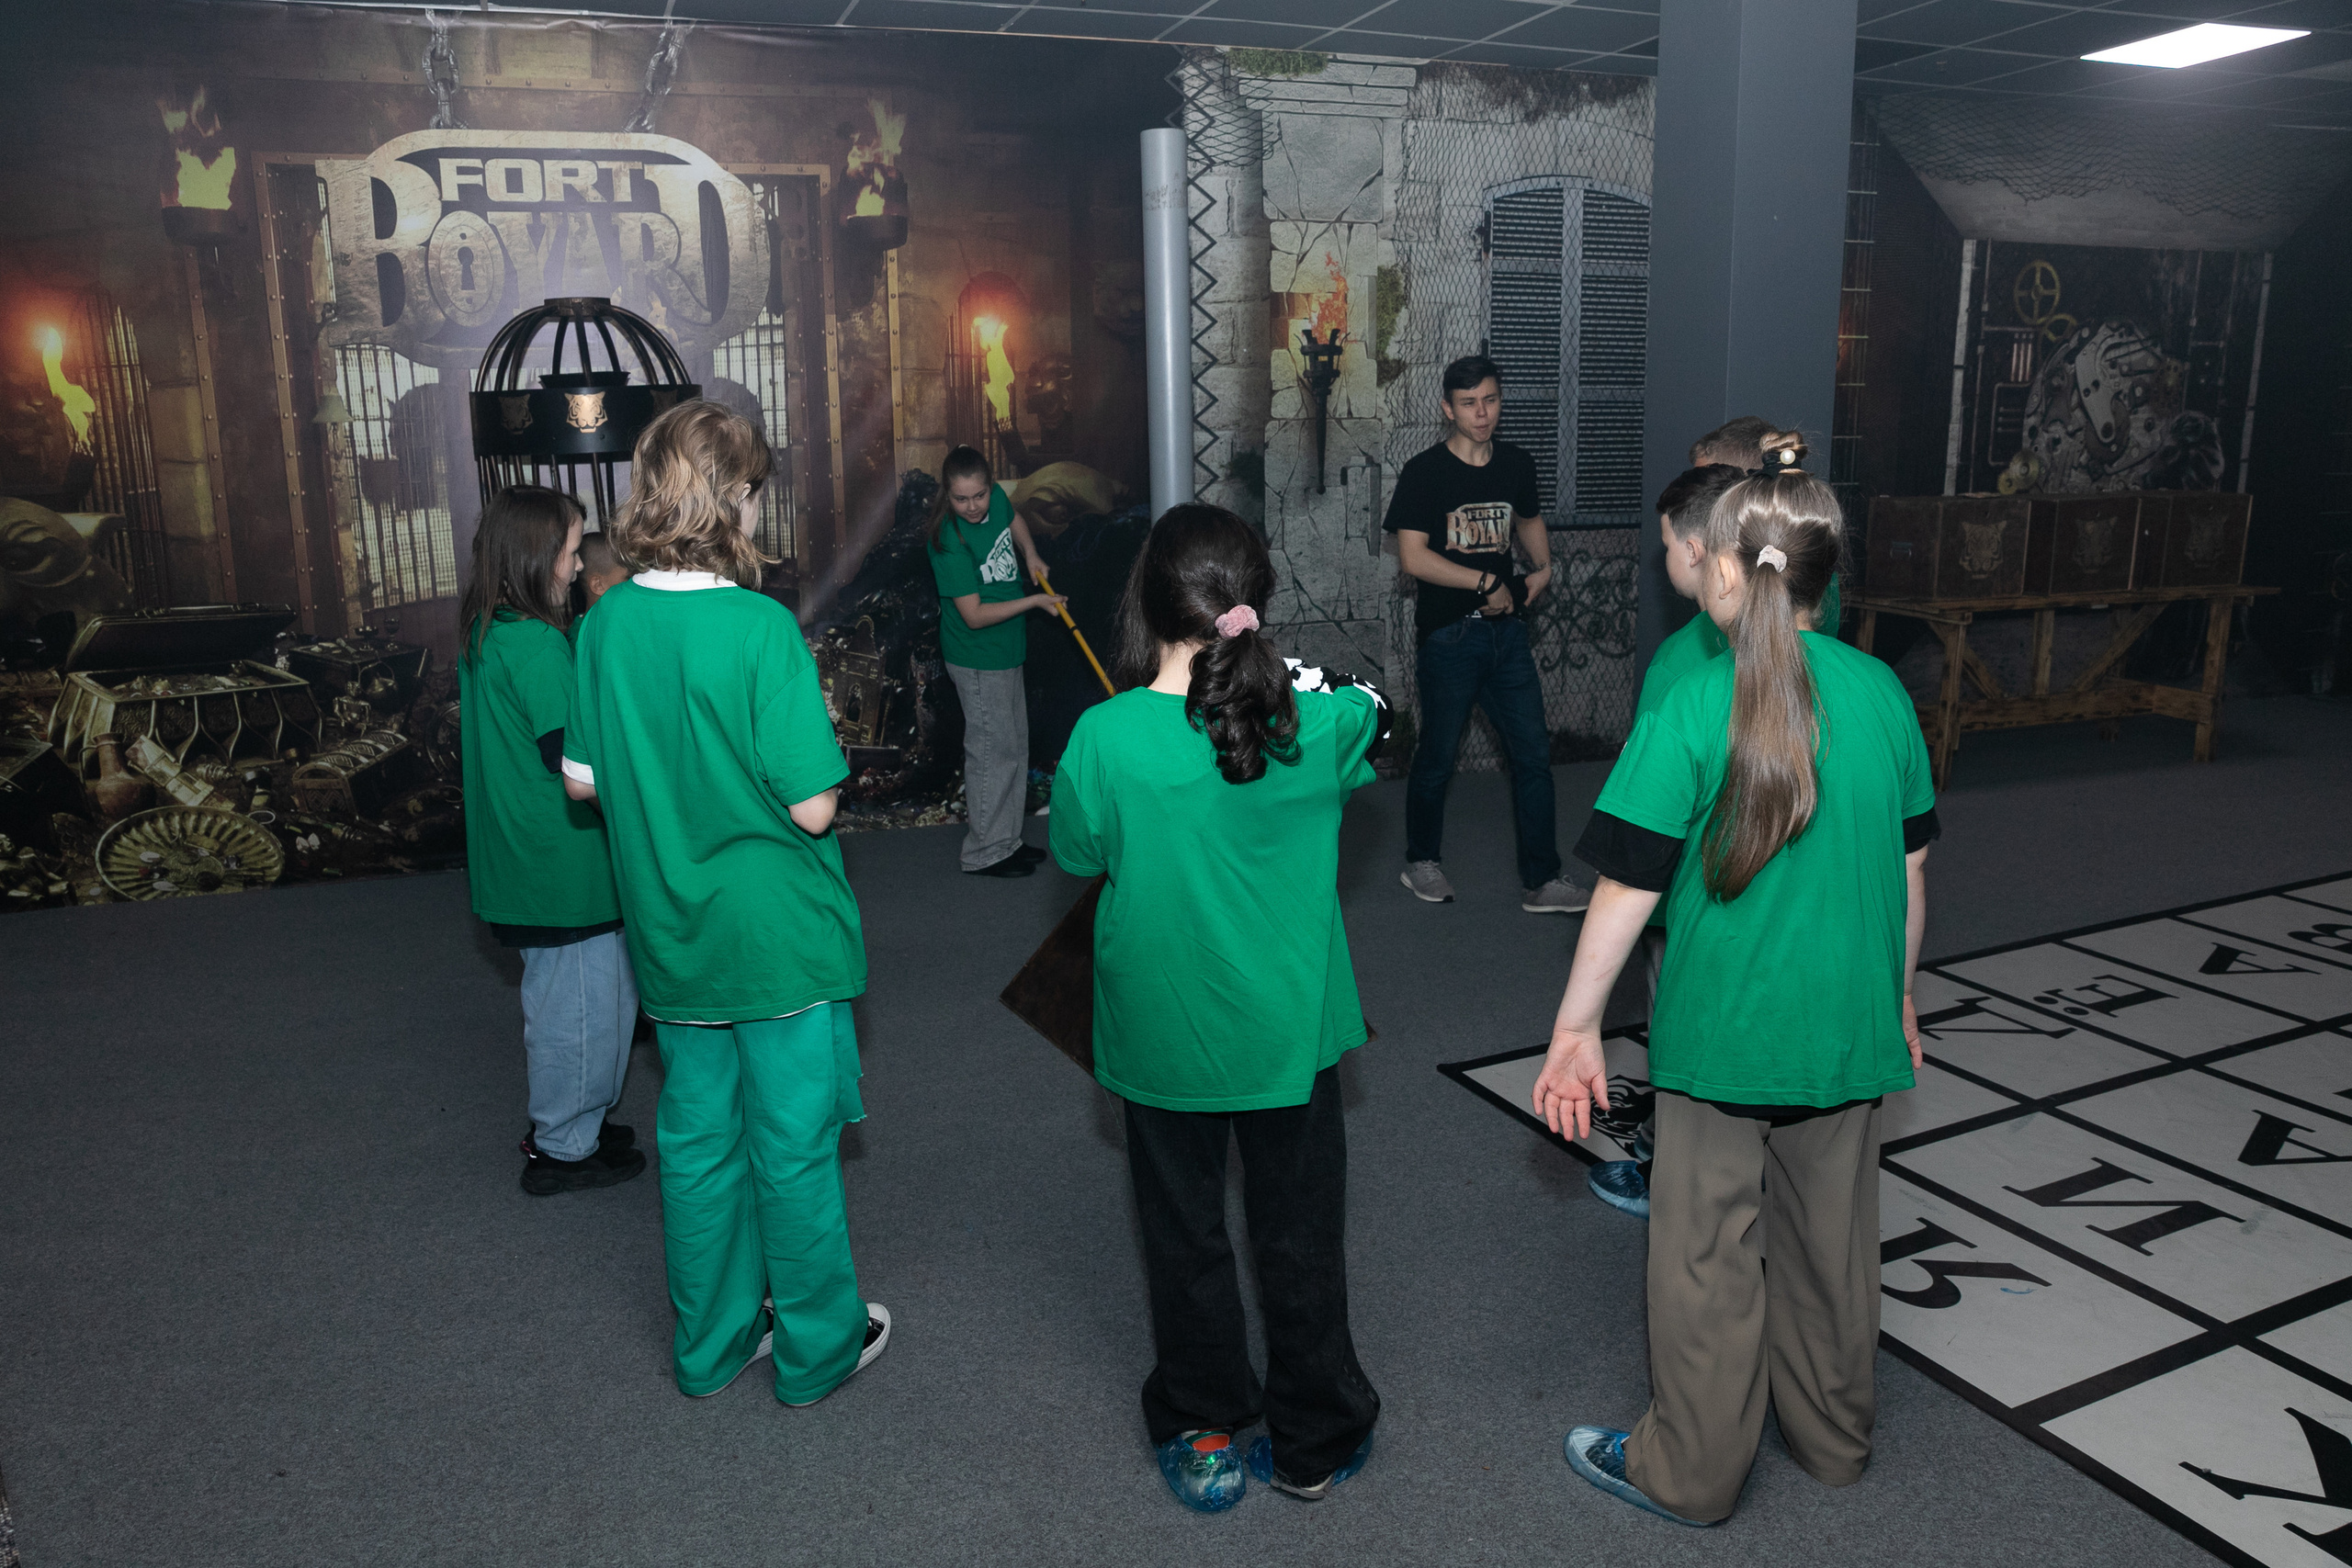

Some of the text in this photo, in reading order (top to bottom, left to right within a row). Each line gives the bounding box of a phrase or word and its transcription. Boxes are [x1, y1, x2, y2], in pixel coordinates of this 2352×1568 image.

[438, 158, 643, 203] FORT
[315, 158, 771, 348] BOYARD
[1445, 508, 1512, 551] BOYA
[1467, 508, 1504, 520] FORT
[2198, 942, 2322, 976] А
[2033, 975, 2180, 1018] Ё
[2001, 1157, 2247, 1257] И
